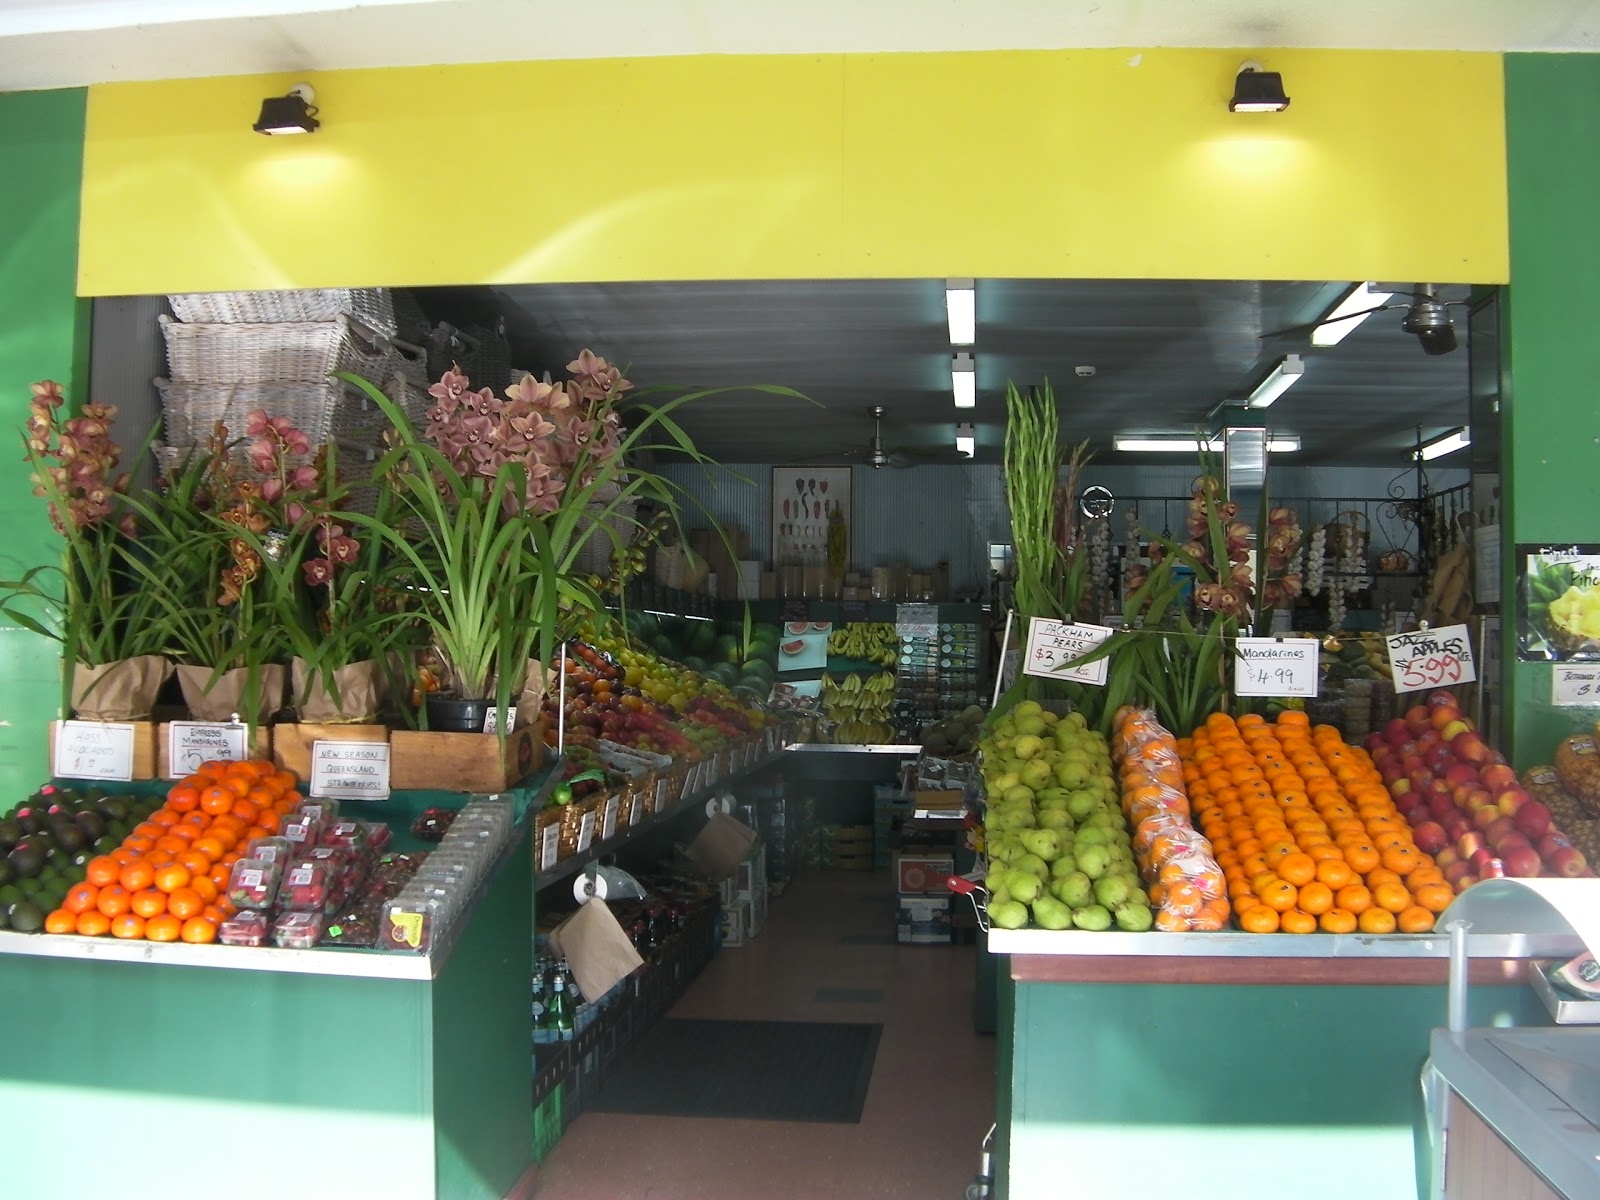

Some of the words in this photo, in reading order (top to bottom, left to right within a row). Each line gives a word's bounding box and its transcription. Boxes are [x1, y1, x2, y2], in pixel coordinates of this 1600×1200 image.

[1539, 545, 1579, 562] Finest
[1044, 624, 1093, 640] PACKHAM
[1053, 638, 1083, 650] PEARS
[1413, 638, 1463, 658] APPLES
[1247, 668, 1294, 685] $4.99
[1395, 654, 1461, 687] $5.99
[321, 750, 339, 758] NEW
[327, 764, 374, 774] QUEENSLAND
